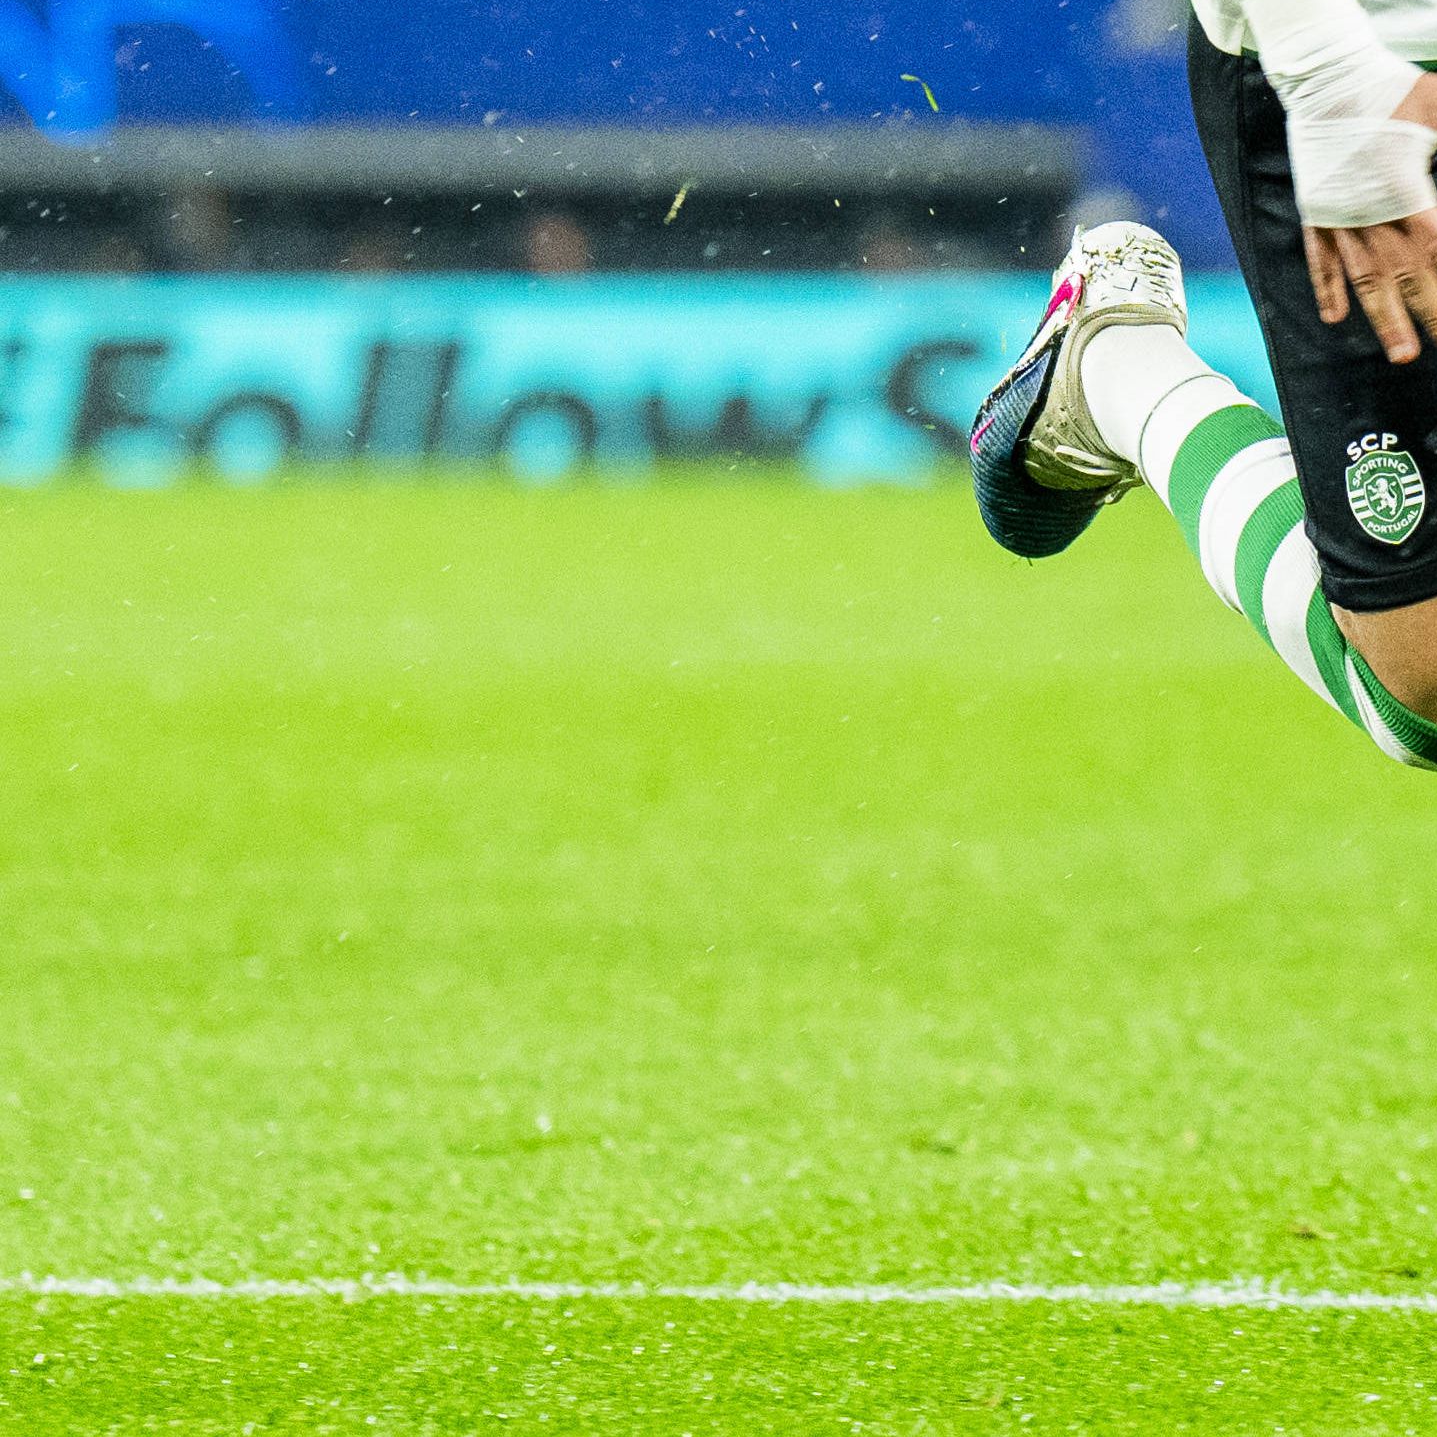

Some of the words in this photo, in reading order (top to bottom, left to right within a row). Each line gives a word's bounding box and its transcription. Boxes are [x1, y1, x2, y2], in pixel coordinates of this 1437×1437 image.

[1346, 433, 1398, 461] SCP
[1352, 457, 1409, 487] SPORTING
[1367, 510, 1418, 533] PORTUGAL
